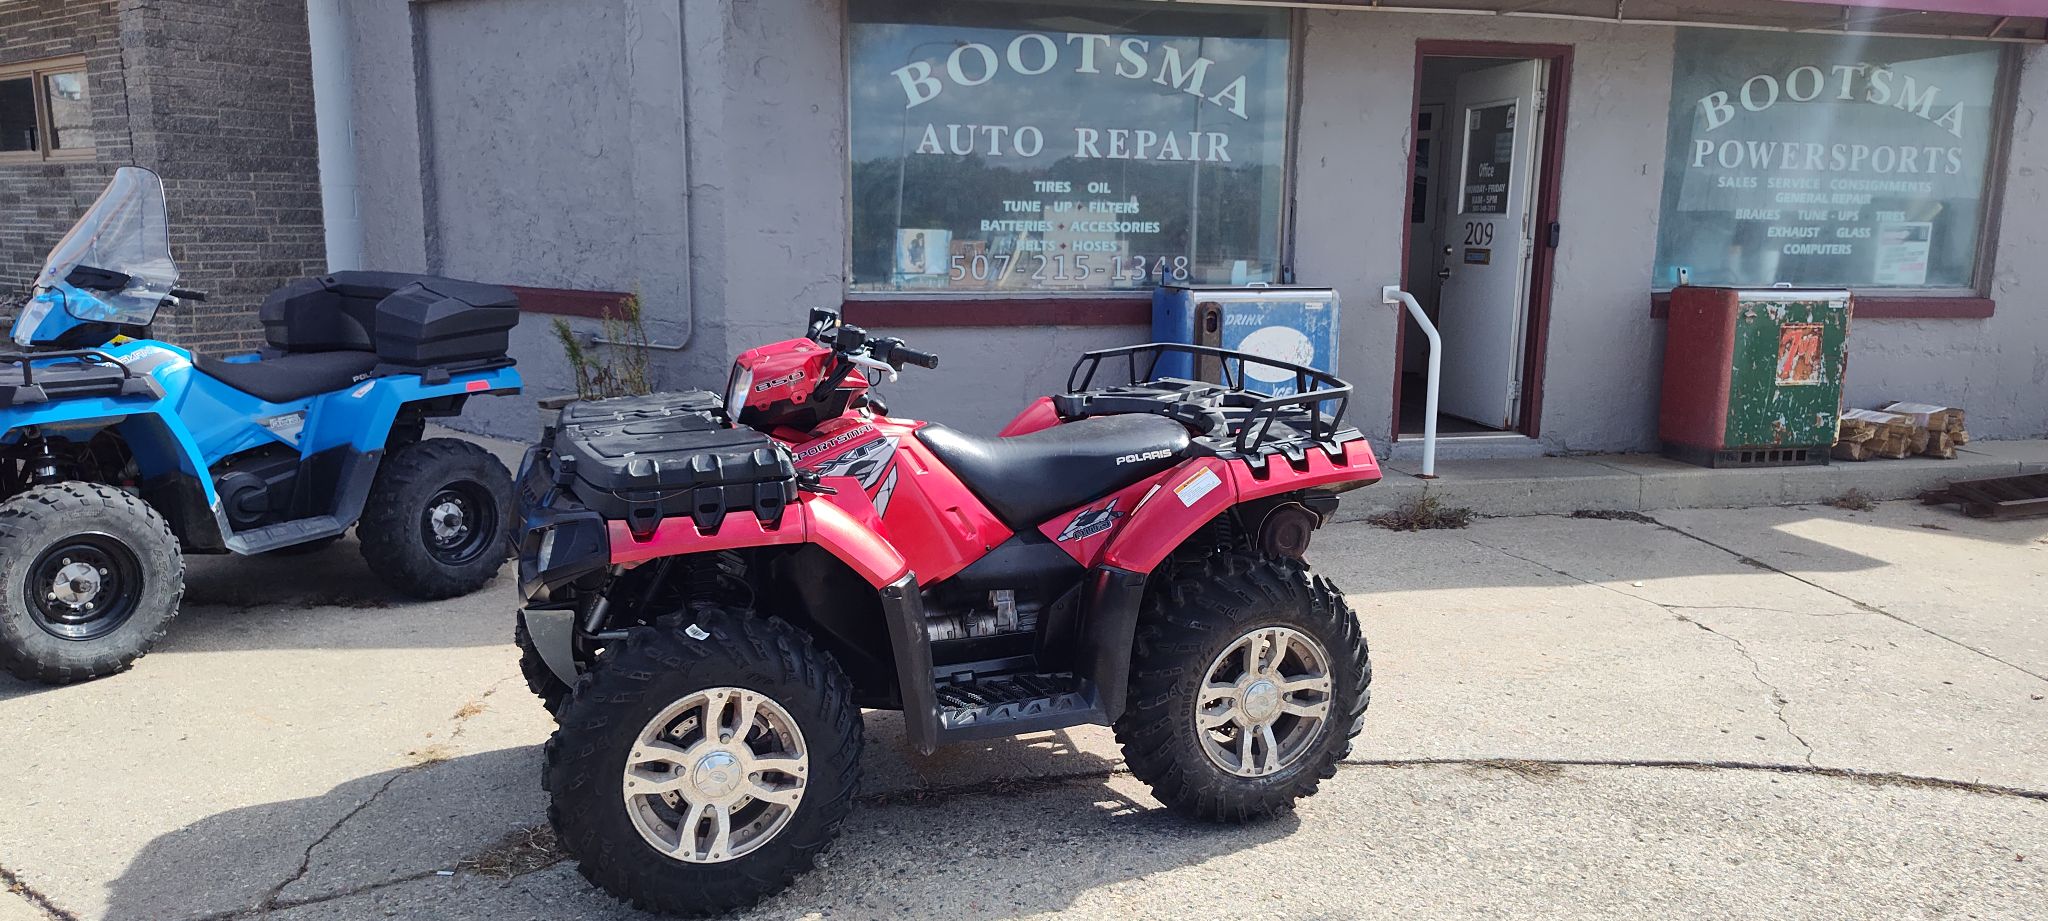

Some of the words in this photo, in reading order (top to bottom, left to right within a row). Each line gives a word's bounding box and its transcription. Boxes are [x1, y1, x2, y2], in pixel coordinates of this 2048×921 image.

[891, 33, 1249, 120] BOOTSMA
[1698, 63, 1965, 139] BOOTSMA
[916, 123, 1044, 157] AUTO
[1074, 127, 1231, 162] REPAIR
[1692, 139, 1963, 174] POWERSPORTS
[1479, 162, 1494, 177] Office
[1033, 181, 1071, 193] TIRES
[1087, 182, 1111, 194] OIL
[1488, 183, 1505, 193] FRIDAY
[1718, 176, 1757, 188] SALES
[1767, 178, 1820, 190] SERVICE
[1830, 178, 1932, 192] CONSIGNMENTS
[1776, 192, 1829, 204] GENERAL
[1832, 193, 1872, 205] REPAIR
[1003, 200, 1041, 213] TUNE
[1054, 201, 1073, 213] UP
[1089, 202, 1140, 214] FILTERS
[1735, 208, 1780, 220] BRAKES
[1798, 209, 1827, 221] TUNE
[1838, 210, 1859, 221] UPS
[1876, 211, 1905, 222] TIRES
[981, 219, 1053, 232] BATTERIES
[1070, 221, 1160, 233] ACCESSORIES
[1767, 226, 1820, 238] EXHAUST
[1836, 227, 1871, 238] GLASS
[1464, 222, 1493, 246] 209
[1016, 239, 1056, 251] BELTS
[1072, 240, 1118, 251] HOSES
[1783, 243, 1852, 255] COMPUTERS
[951, 254, 1189, 282] 507-215-1348
[1225, 314, 1265, 326] DRINK
[755, 369, 805, 392] 850
[1116, 449, 1172, 466] POLARIS
